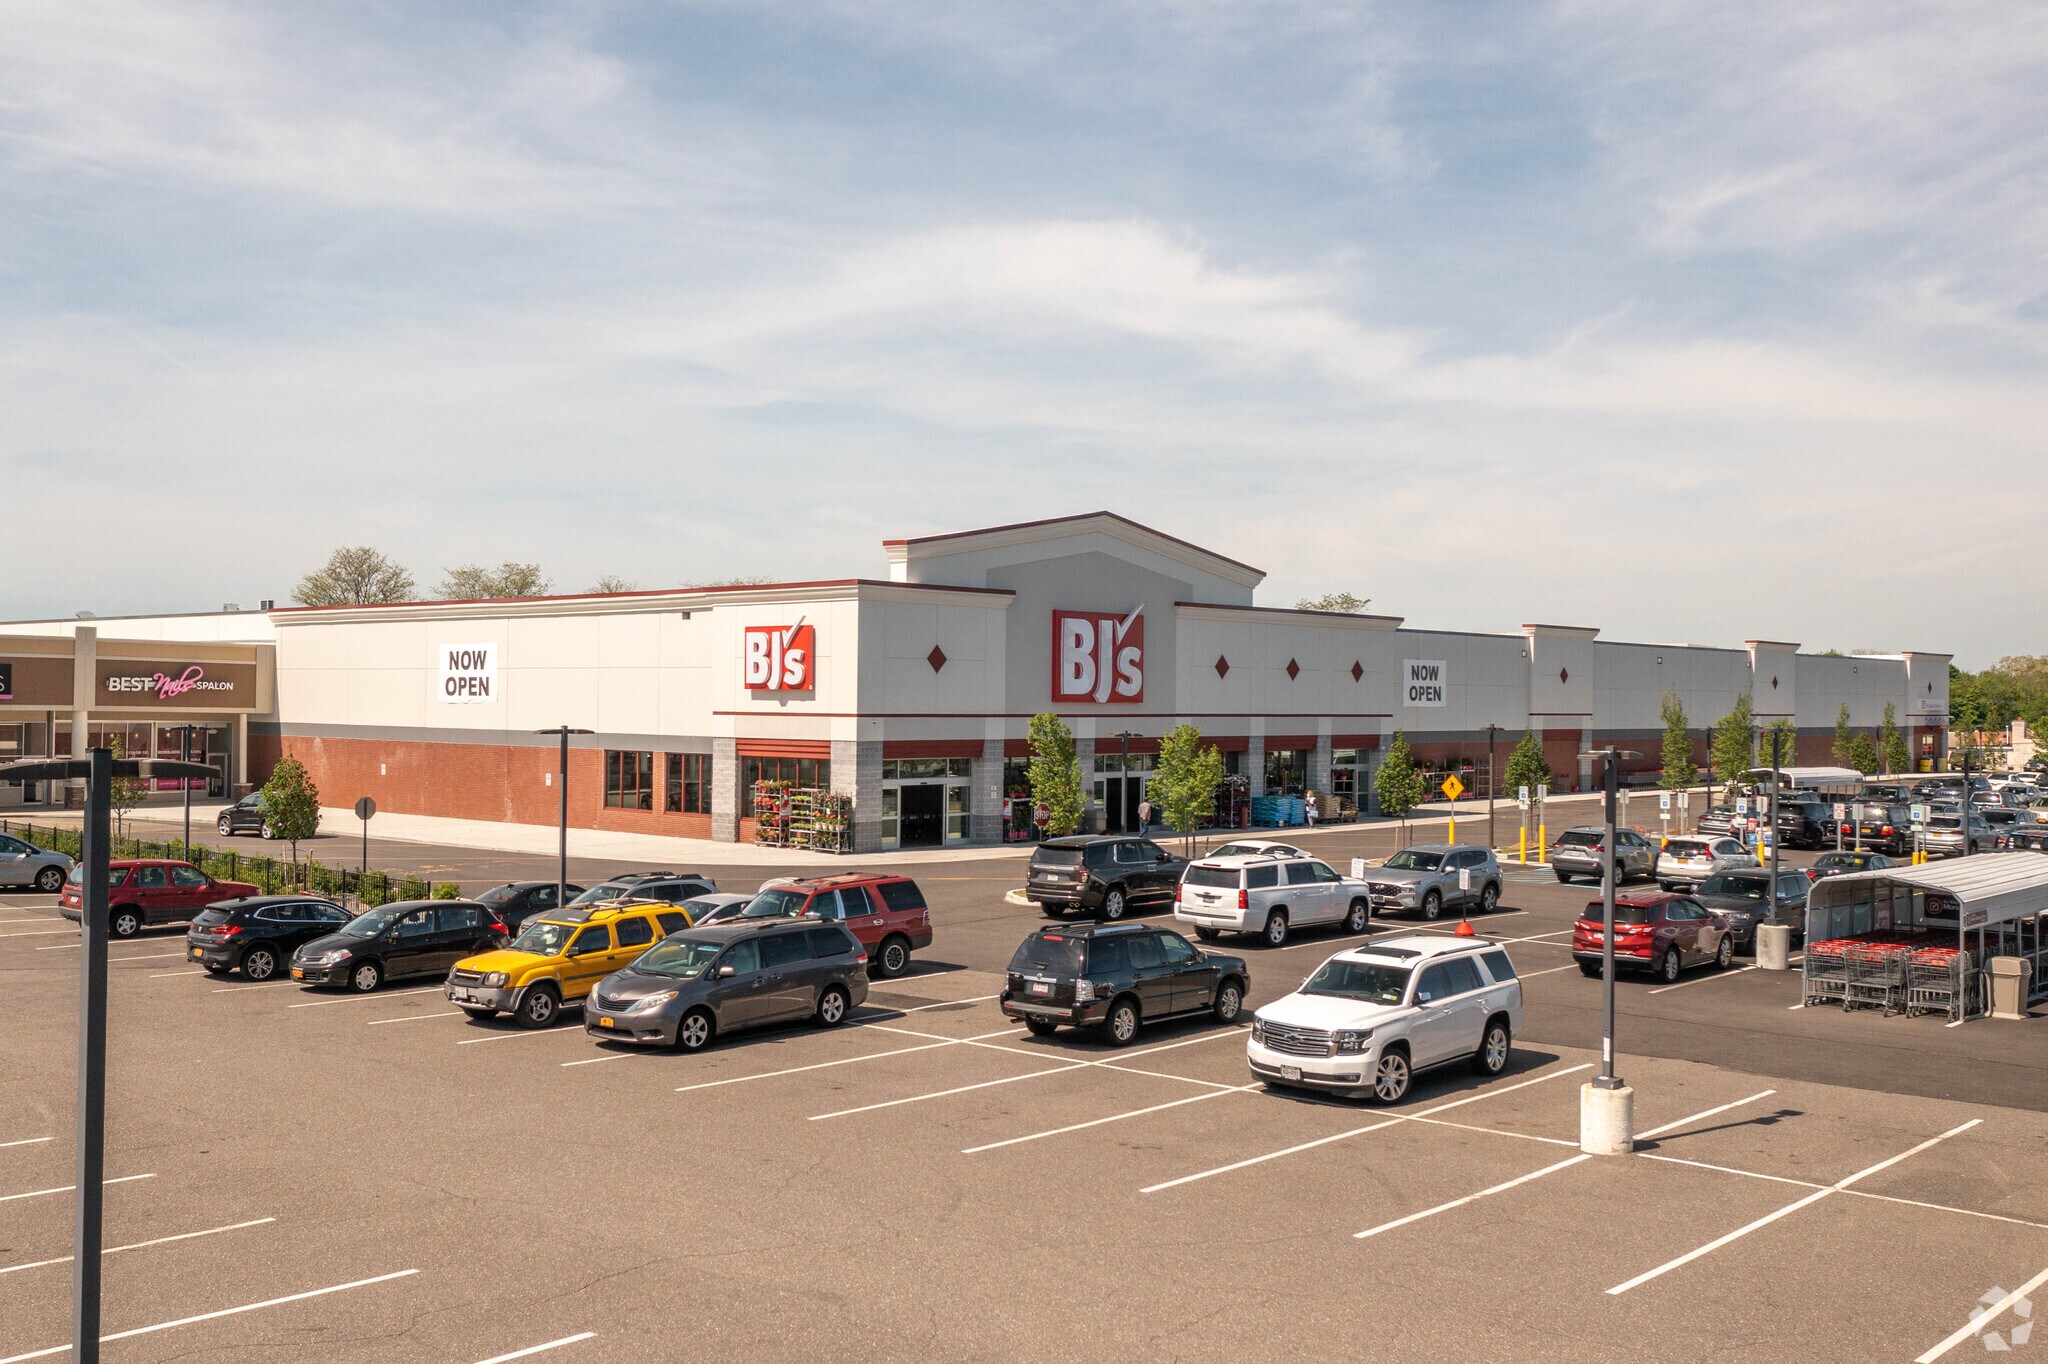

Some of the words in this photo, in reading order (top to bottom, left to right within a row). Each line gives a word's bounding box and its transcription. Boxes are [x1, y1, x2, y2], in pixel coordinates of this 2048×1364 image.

[449, 650, 487, 670] NOW
[745, 615, 807, 690] BJ's
[1061, 603, 1145, 703] BJ's
[108, 677, 152, 692] BEST
[152, 666, 204, 699] Nails
[196, 681, 234, 691] SPALON
[1411, 664, 1439, 681] NOW
[445, 676, 490, 696] OPEN
[1409, 685, 1442, 702] OPEN
[1036, 811, 1050, 820] STOP
